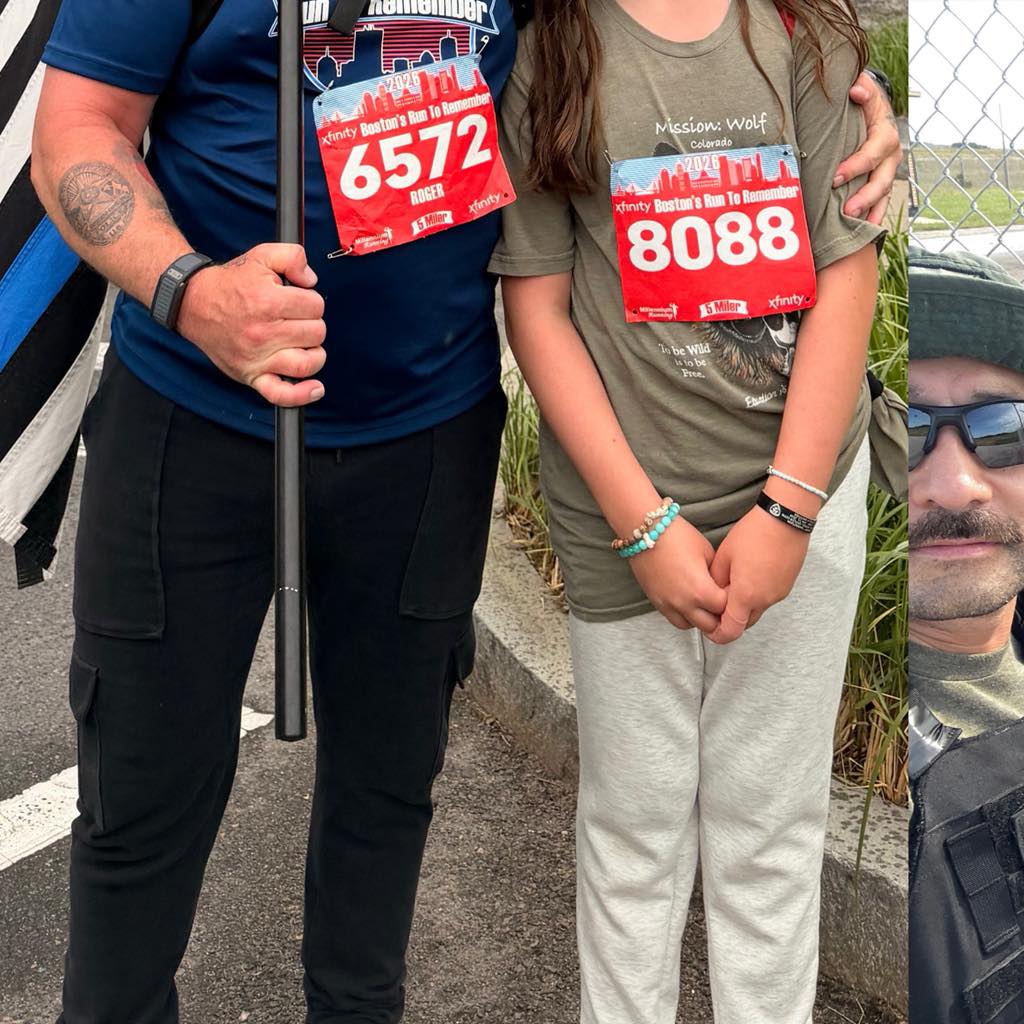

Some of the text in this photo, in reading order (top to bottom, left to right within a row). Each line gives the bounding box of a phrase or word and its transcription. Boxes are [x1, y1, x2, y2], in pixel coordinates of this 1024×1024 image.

[386, 72, 421, 94] 2026
[360, 92, 492, 137] Boston's Run To Remember
[655, 112, 768, 136] Mission: Wolf
[322, 127, 357, 145] xfinity
[690, 138, 733, 150] Colorado
[340, 113, 492, 200] 6572
[684, 155, 721, 173] 2026
[410, 183, 445, 206] ROGER
[468, 192, 501, 214] xfinity
[654, 185, 799, 214] Boston's Run To Remember
[615, 200, 651, 215] xfinity
[416, 212, 448, 230] 5 Miler
[627, 206, 800, 273] 8088
[705, 299, 741, 314] 5 Miler
[768, 293, 804, 309] xfinity
[671, 345, 686, 356] be
[686, 342, 711, 356] Wild
[694, 357, 708, 367] be
